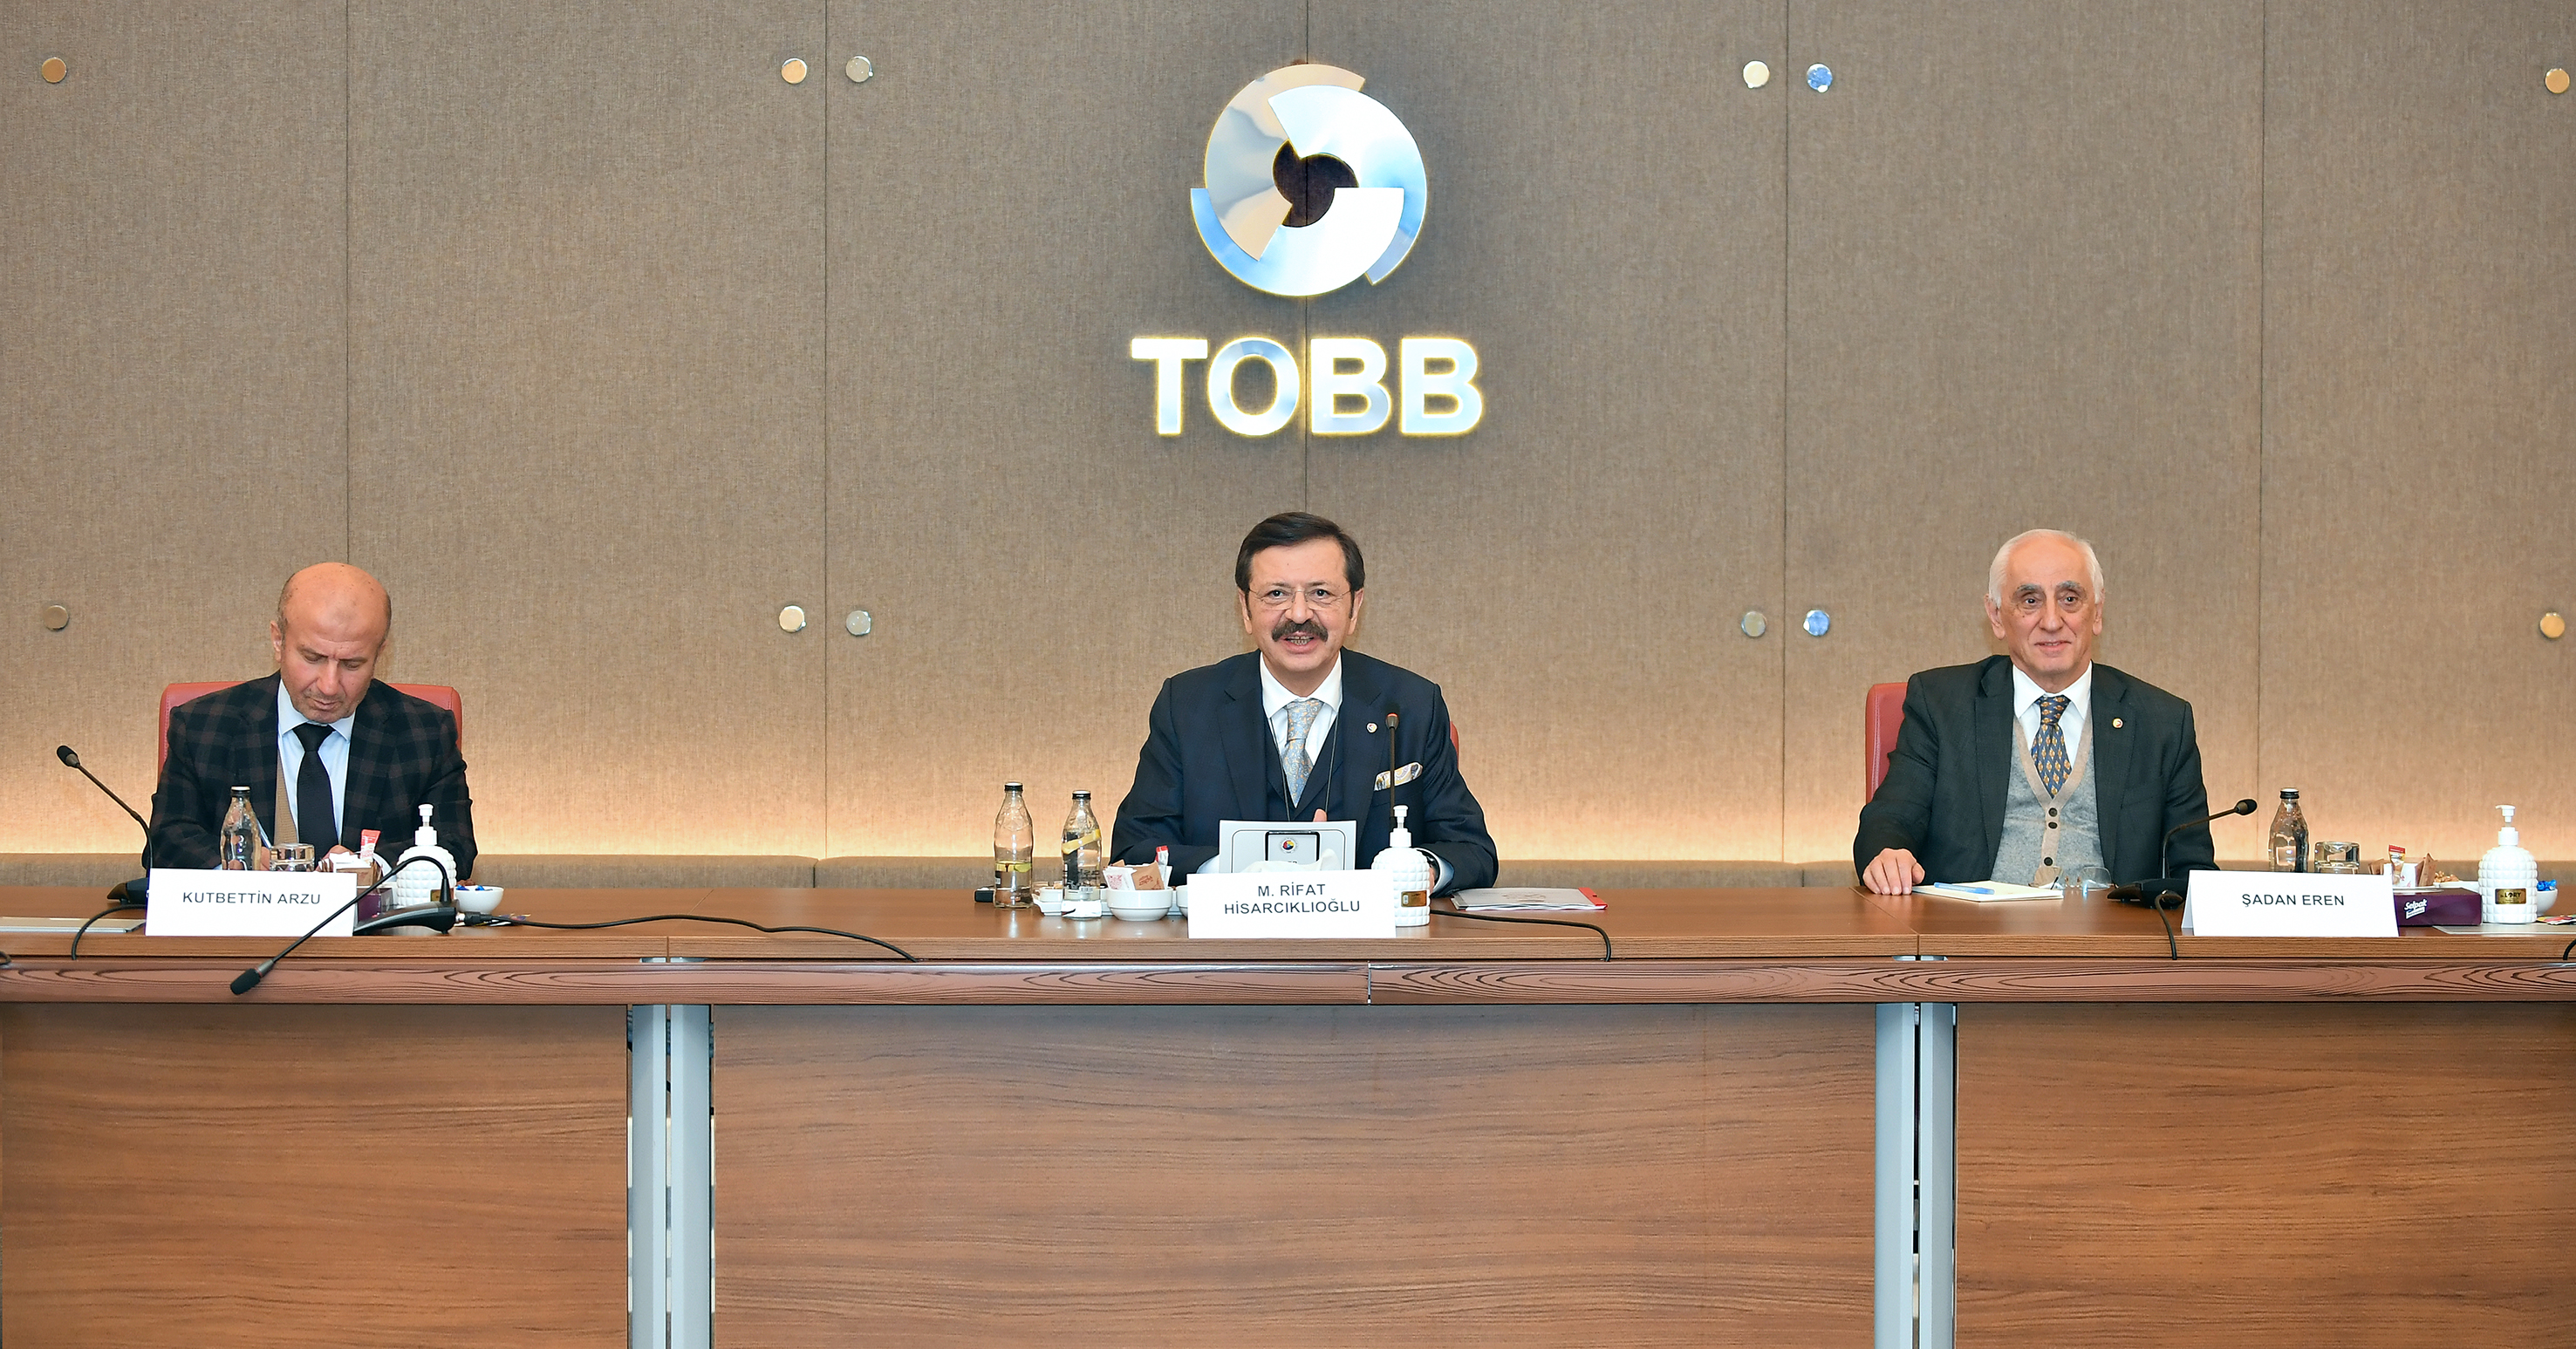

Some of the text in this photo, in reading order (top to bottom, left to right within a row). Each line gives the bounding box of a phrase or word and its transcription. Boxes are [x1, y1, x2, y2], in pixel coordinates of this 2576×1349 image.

[1131, 337, 1483, 436] TOBB
[182, 890, 320, 904] KUTBETTİN ARZU
[1258, 882, 1326, 897] M. RİFAT
[1224, 898, 1360, 915] HİSARCIKLIOĞLU
[2242, 893, 2345, 908] ŞADAN EREN
[2404, 898, 2428, 911] Selpak
